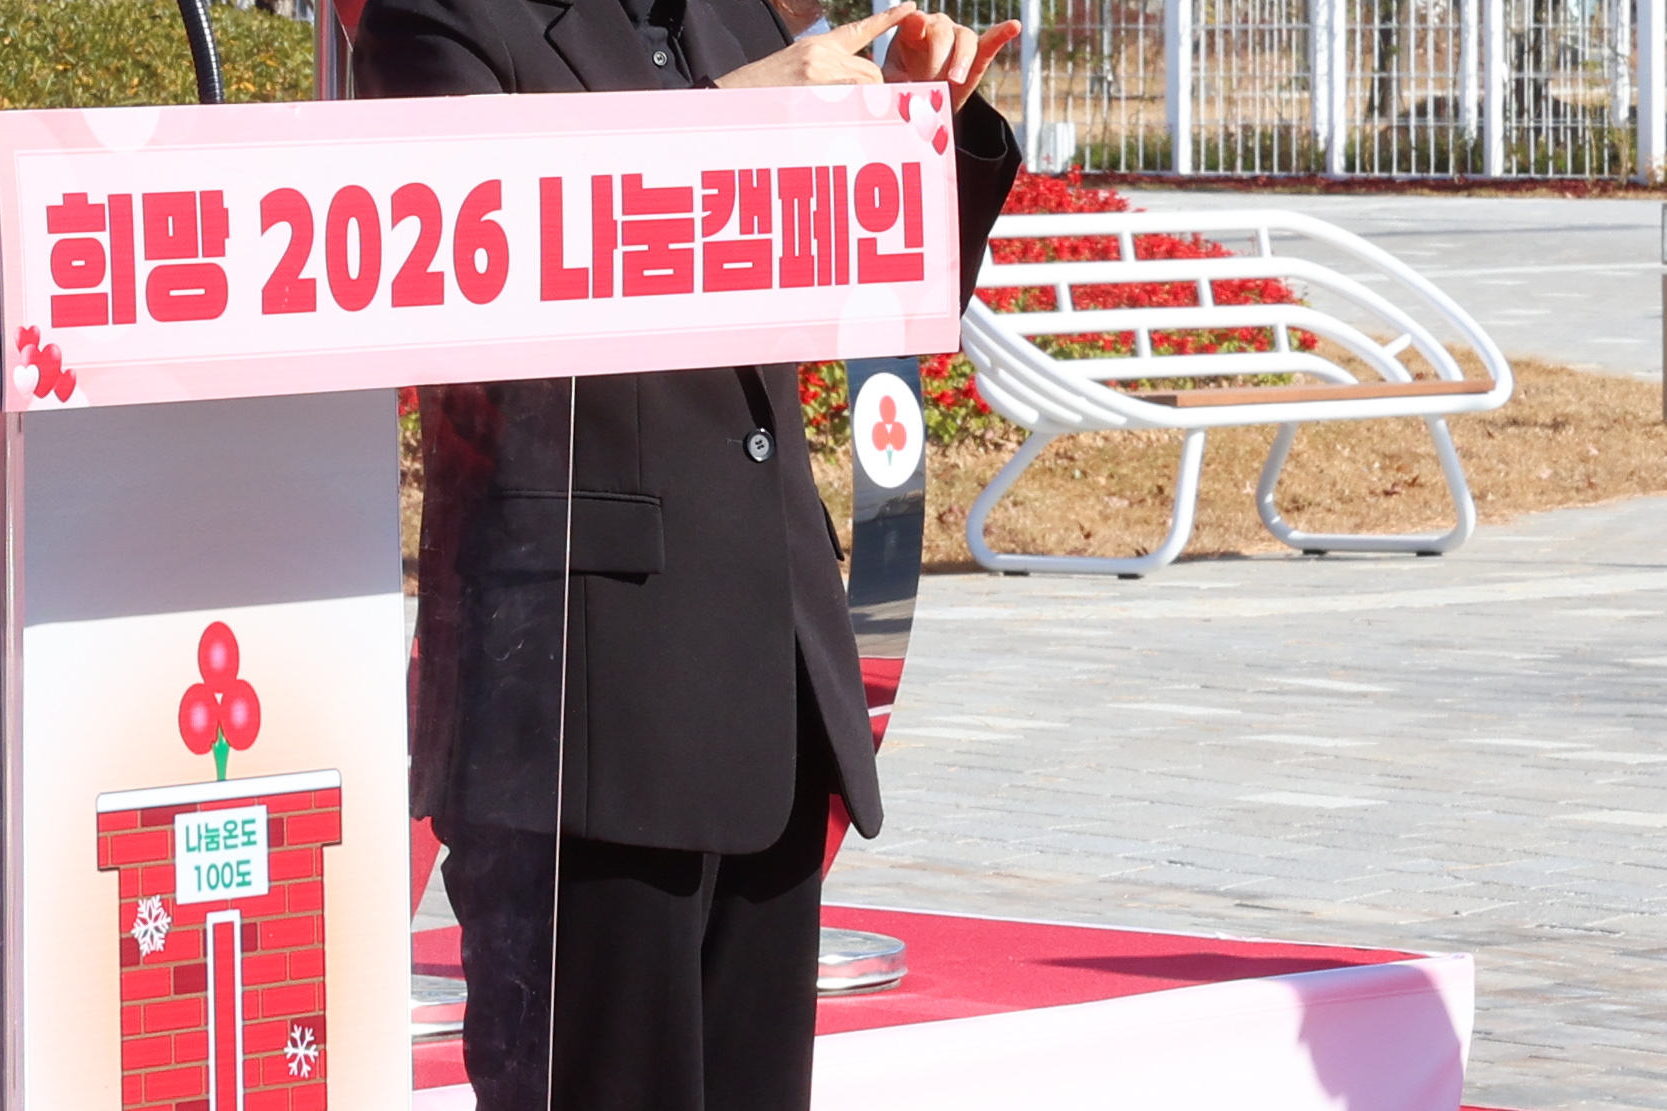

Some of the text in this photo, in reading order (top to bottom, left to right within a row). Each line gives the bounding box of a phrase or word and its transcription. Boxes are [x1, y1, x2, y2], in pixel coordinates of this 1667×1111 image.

[46, 161, 925, 328] 희망 2026 나눔캠페인
[185, 817, 257, 853] 나눔온도
[193, 859, 252, 892] 100도
